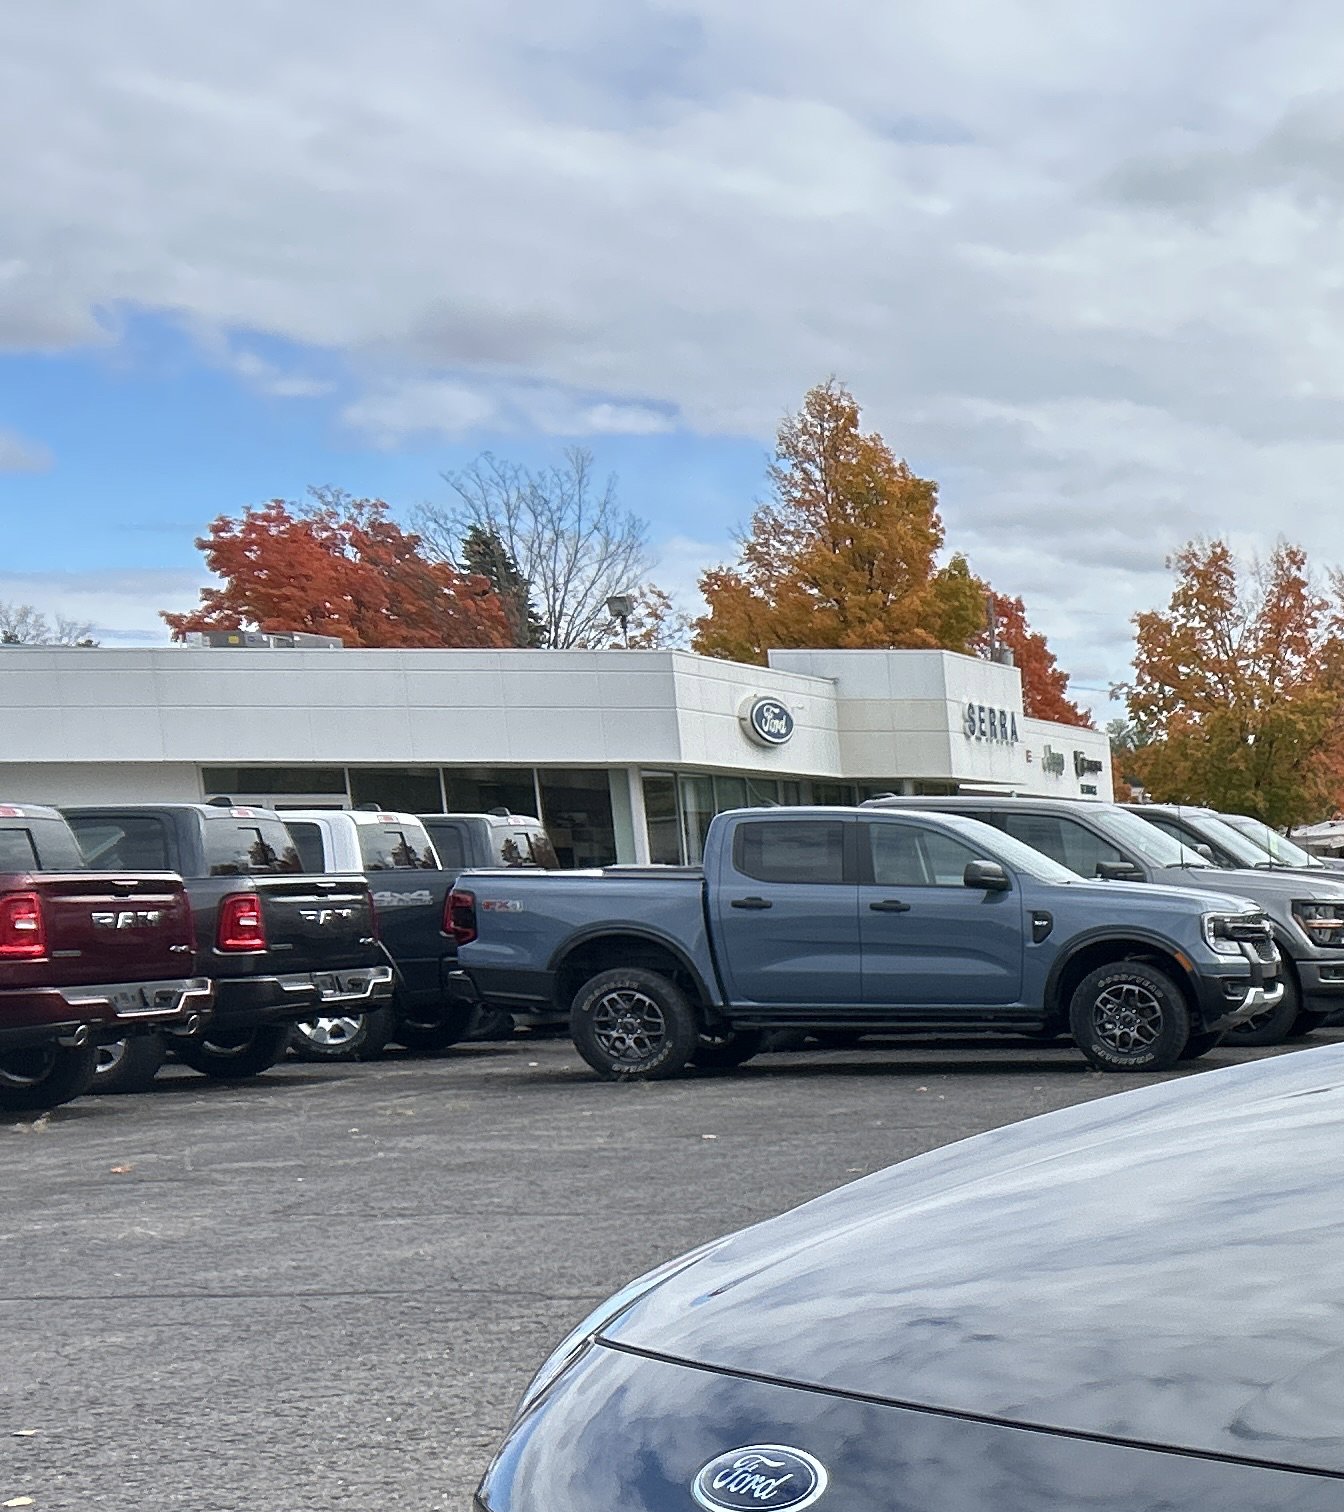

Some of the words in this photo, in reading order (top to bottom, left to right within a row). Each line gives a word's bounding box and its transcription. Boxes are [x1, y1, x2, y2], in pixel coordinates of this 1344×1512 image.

[761, 704, 787, 734] Ford
[966, 702, 1019, 743] SERRA
[712, 1454, 794, 1500] Ford
